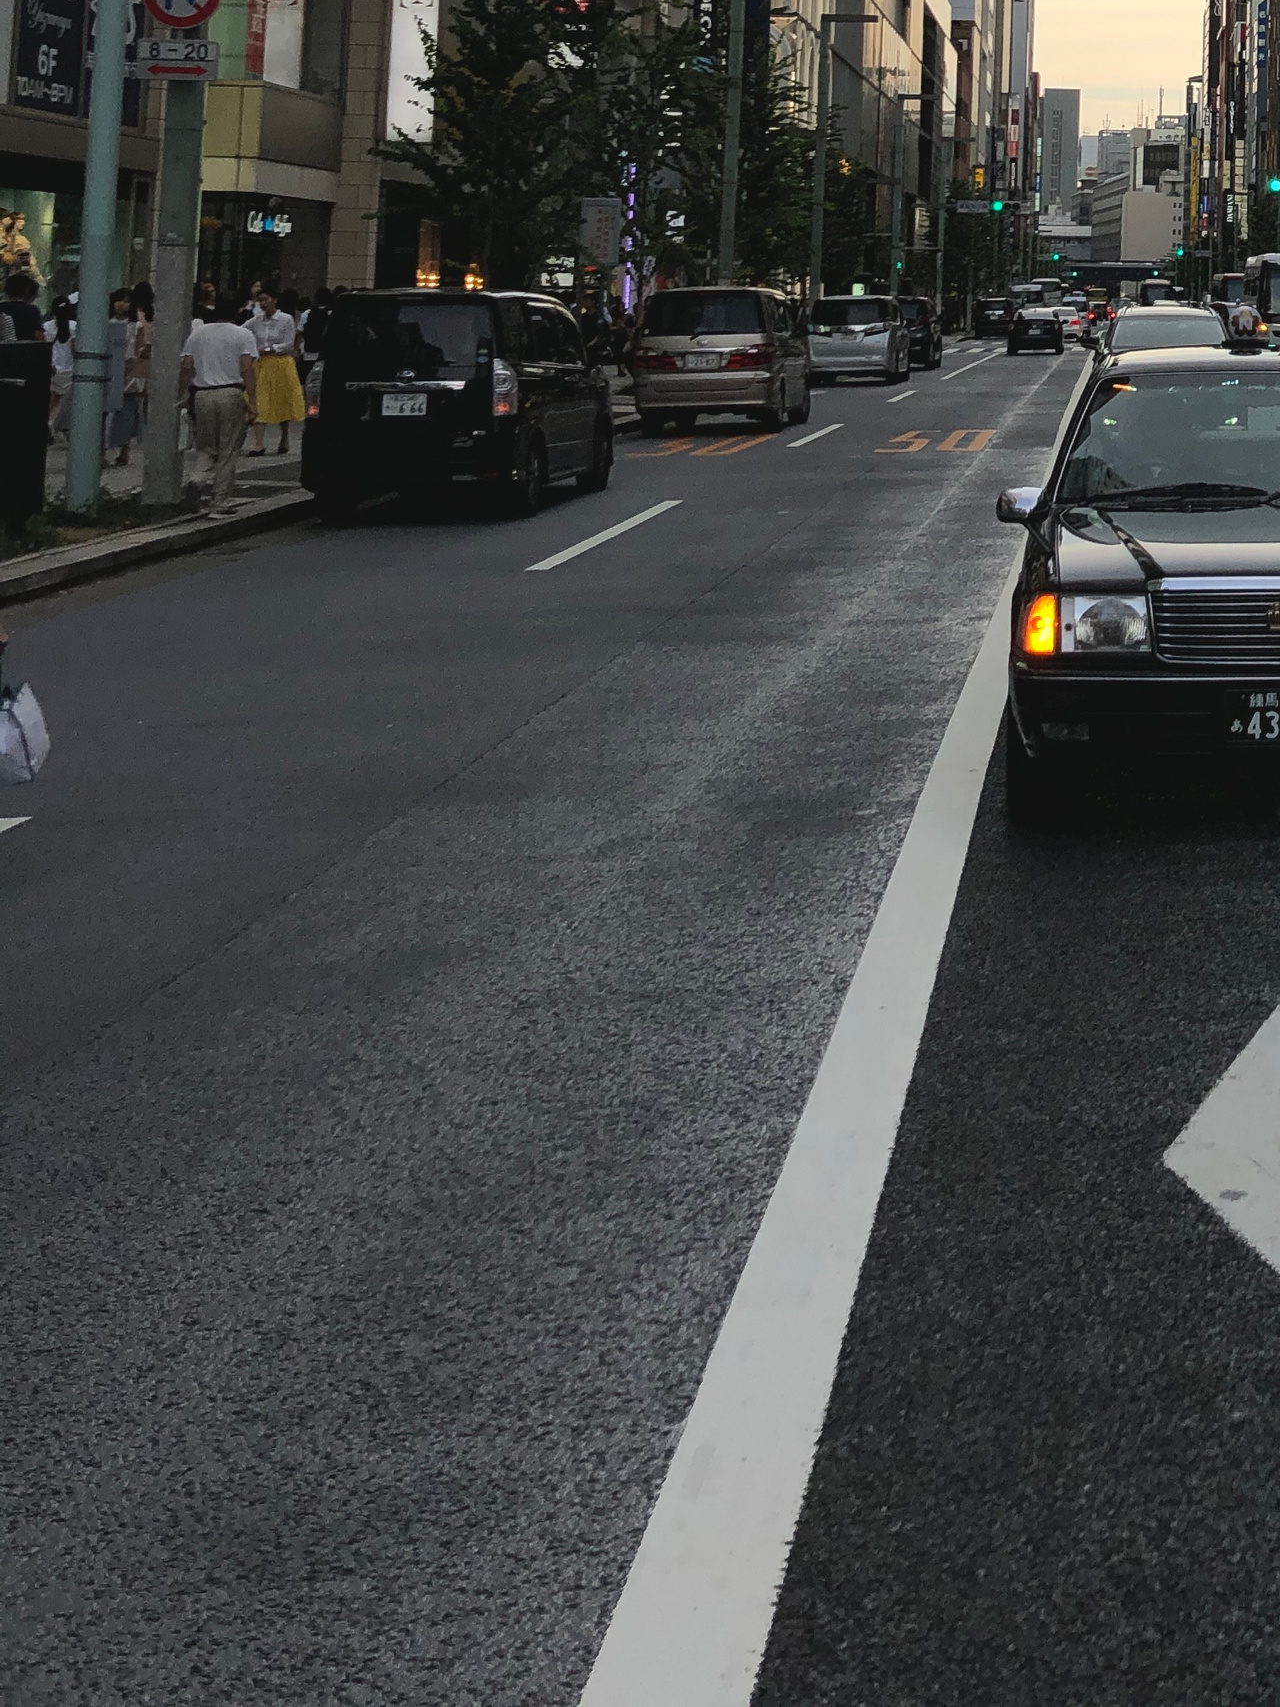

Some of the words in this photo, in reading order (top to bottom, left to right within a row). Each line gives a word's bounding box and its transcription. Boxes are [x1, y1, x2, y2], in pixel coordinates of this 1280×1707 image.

[38, 44, 58, 76] 6F
[874, 429, 987, 454] 50
[1249, 693, 1279, 707] 練馬
[1230, 718, 1243, 733] あ
